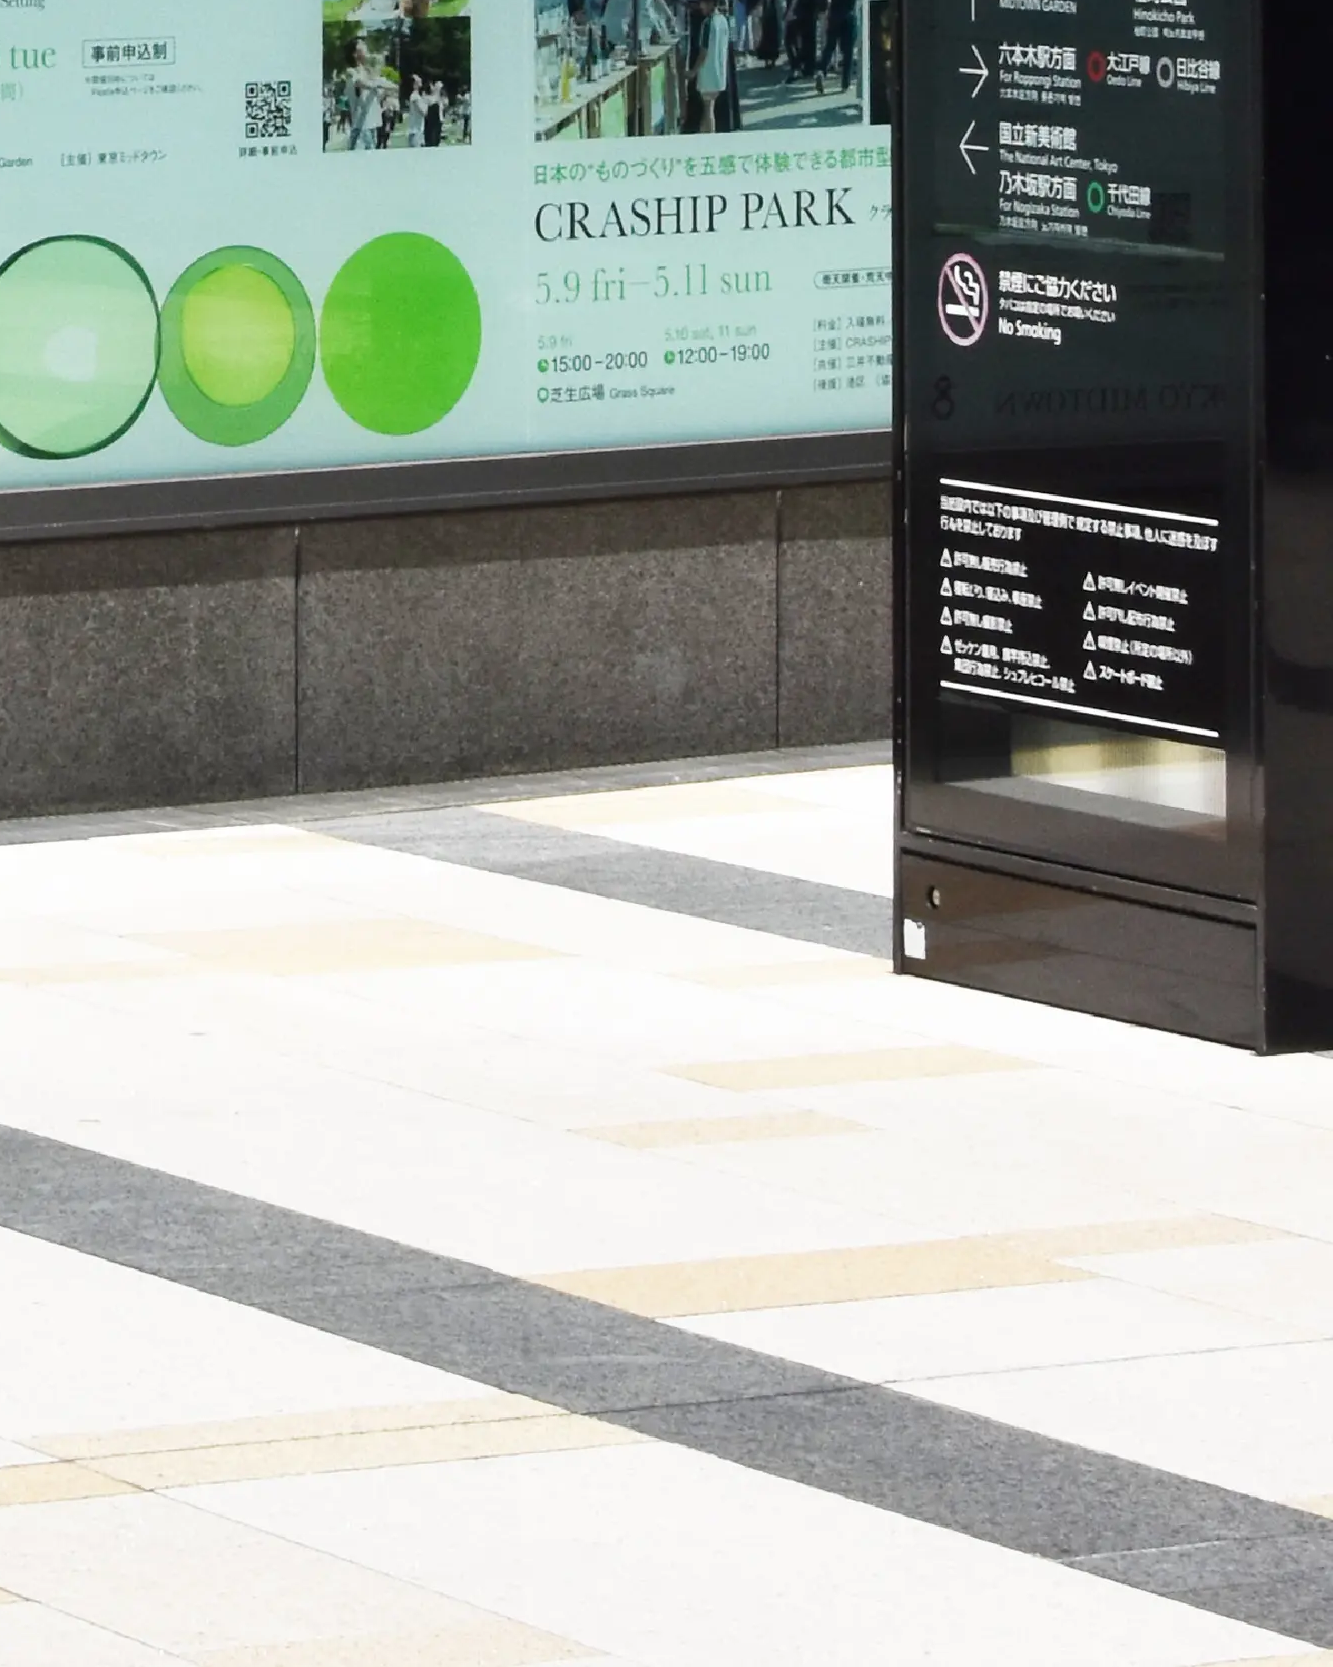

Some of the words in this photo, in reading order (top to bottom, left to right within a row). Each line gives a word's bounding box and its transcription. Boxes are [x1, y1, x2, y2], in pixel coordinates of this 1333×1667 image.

[9, 44, 57, 70] tue
[91, 41, 167, 62] 事前申込制
[999, 41, 1077, 71] 六本木駅方面
[999, 120, 1077, 151] 国立新美術館
[999, 170, 1078, 202] 乃木坂駅方面
[535, 193, 727, 242] CRASHIP
[741, 186, 856, 231] PARK
[535, 270, 580, 305] 5.9
[720, 268, 772, 294] sun
[999, 317, 1014, 335] No
[1015, 320, 1062, 345] Smoking
[550, 384, 604, 404] 芝生広場
